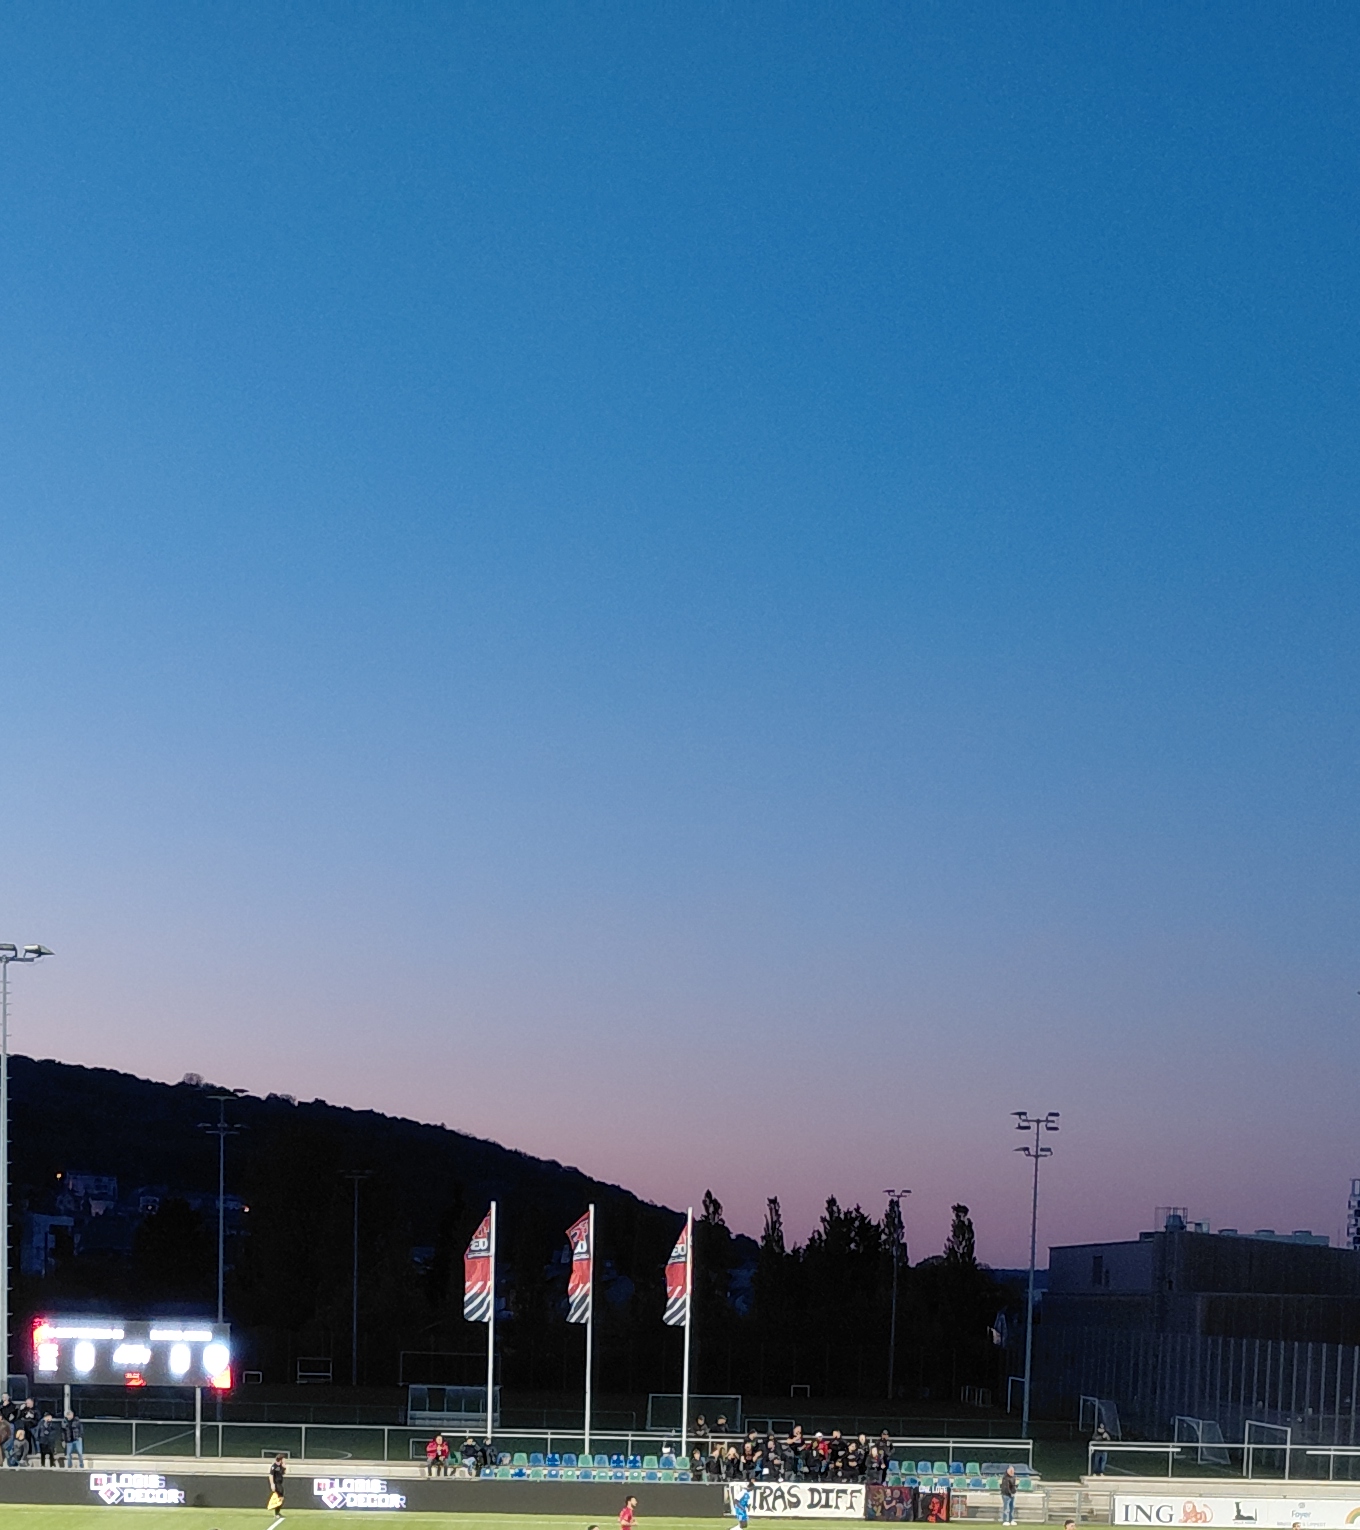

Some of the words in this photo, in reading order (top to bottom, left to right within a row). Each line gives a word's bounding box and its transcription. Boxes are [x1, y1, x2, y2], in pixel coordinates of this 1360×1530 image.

[730, 1484, 802, 1513] TRAS
[806, 1487, 864, 1512] DIFF
[1122, 1503, 1175, 1524] ING
[1291, 1509, 1312, 1520] Foyer
